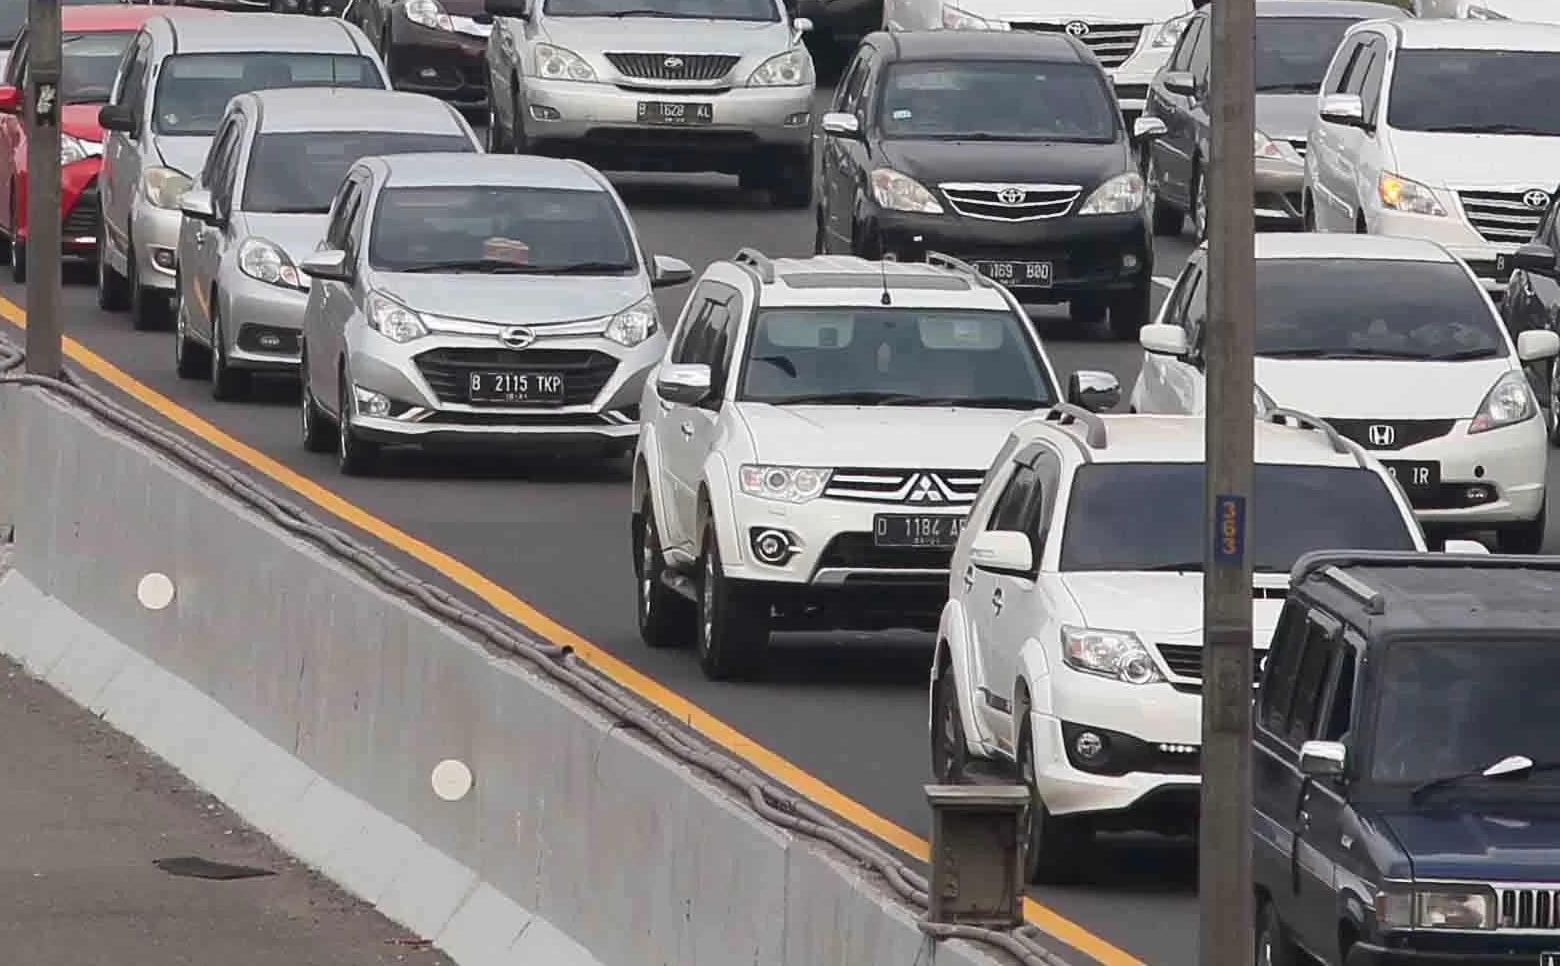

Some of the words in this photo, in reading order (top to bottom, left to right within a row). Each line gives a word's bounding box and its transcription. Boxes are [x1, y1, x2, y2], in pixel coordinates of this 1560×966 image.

[472, 374, 481, 391] B
[495, 375, 528, 392] 2115
[536, 375, 561, 393] TKP
[905, 518, 939, 537] 1184
